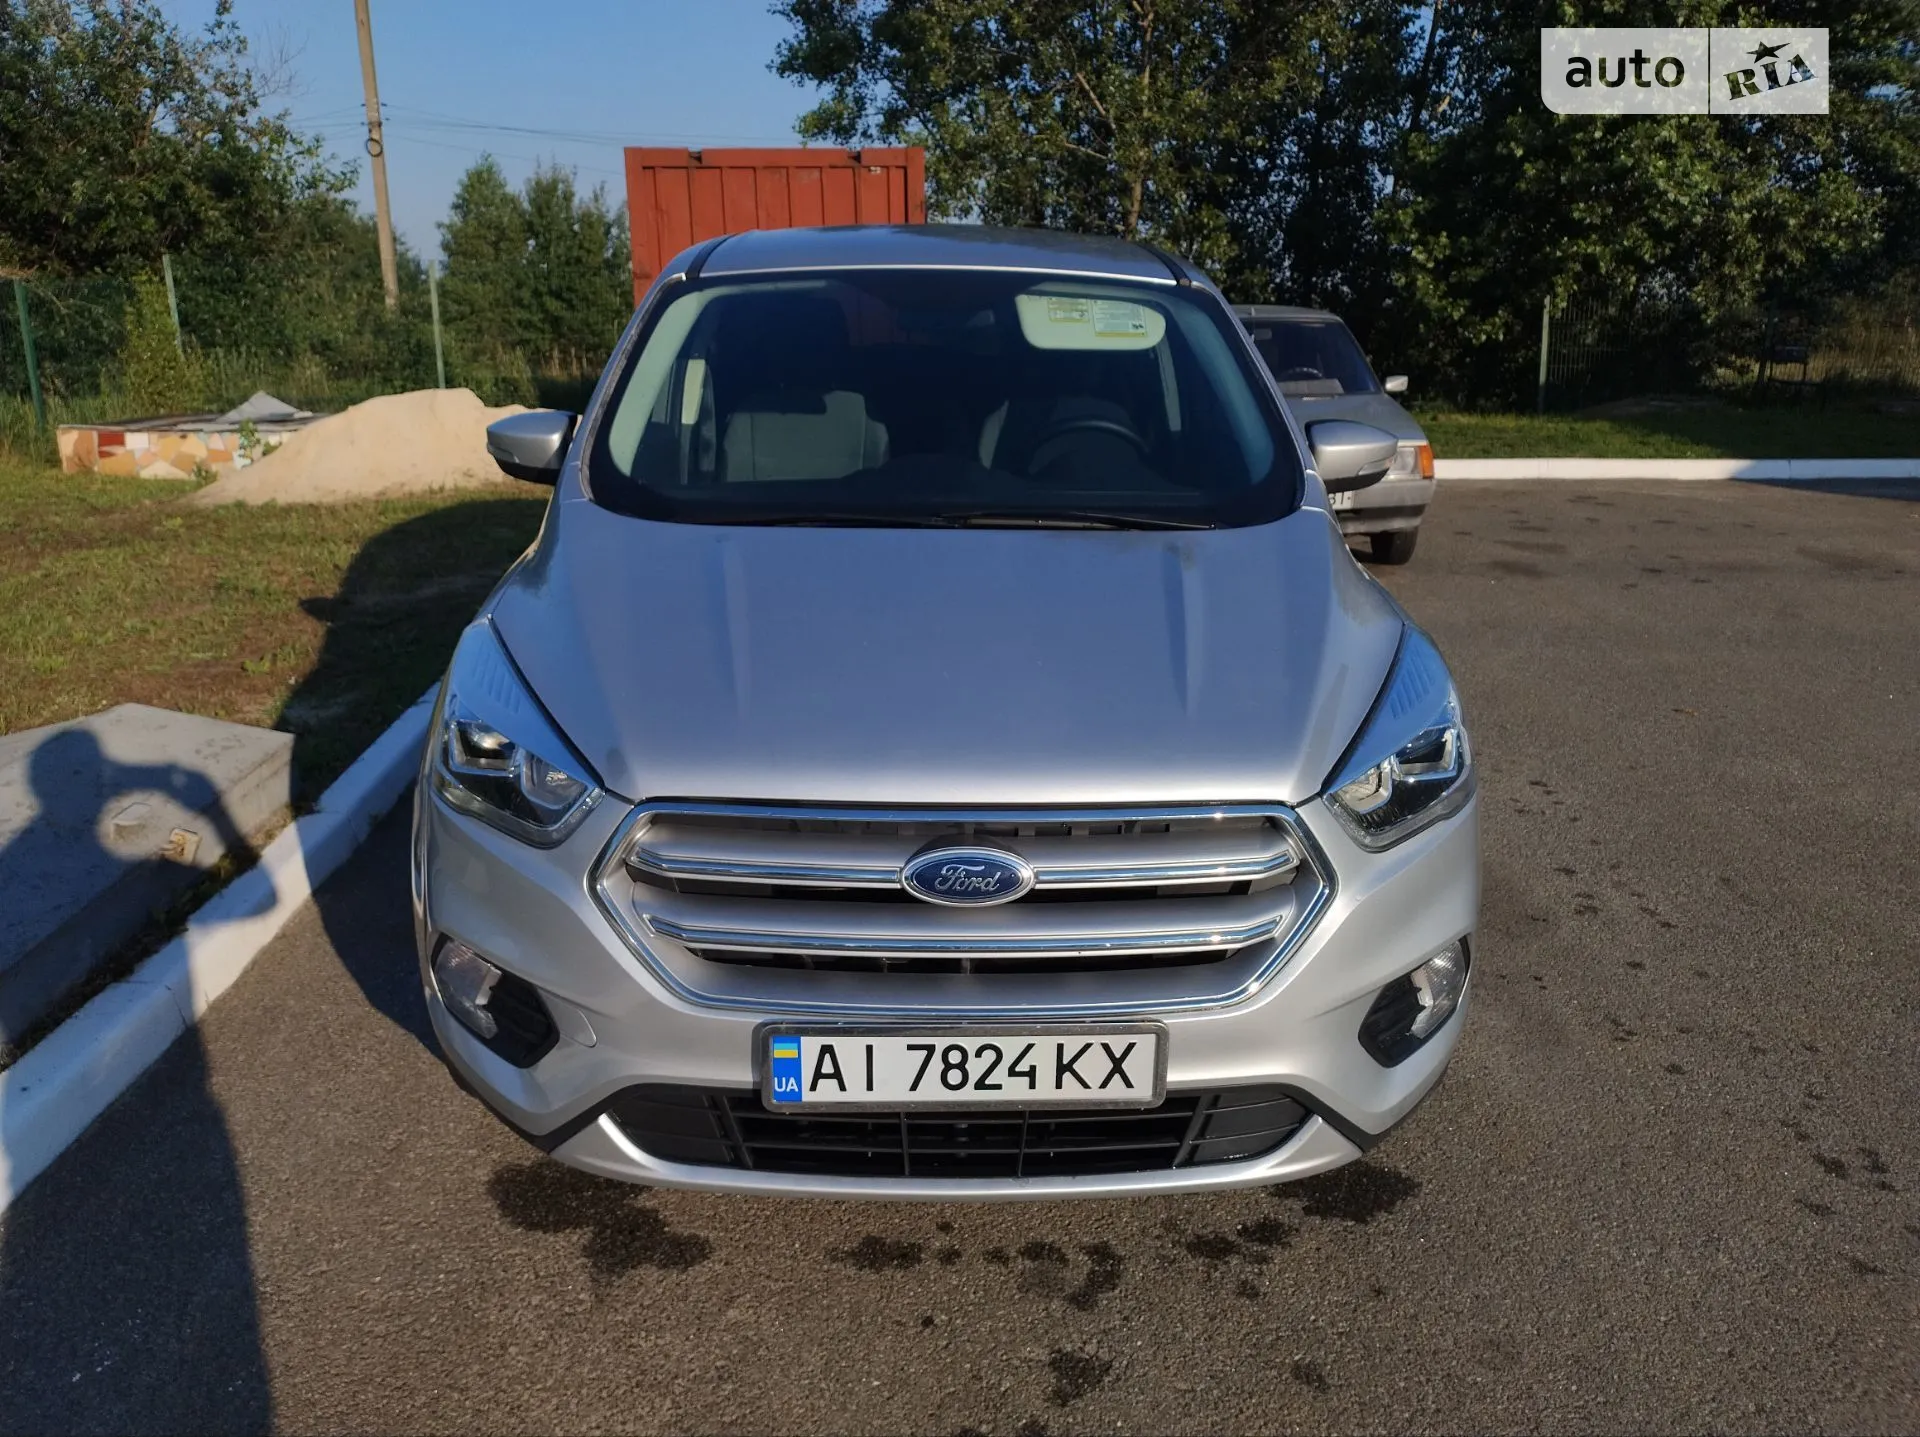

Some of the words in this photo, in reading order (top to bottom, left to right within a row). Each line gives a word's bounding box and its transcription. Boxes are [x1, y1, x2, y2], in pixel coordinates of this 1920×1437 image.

[934, 864, 1001, 892] Ford
[905, 1042, 1037, 1091] 7824
[774, 1077, 799, 1092] UA
